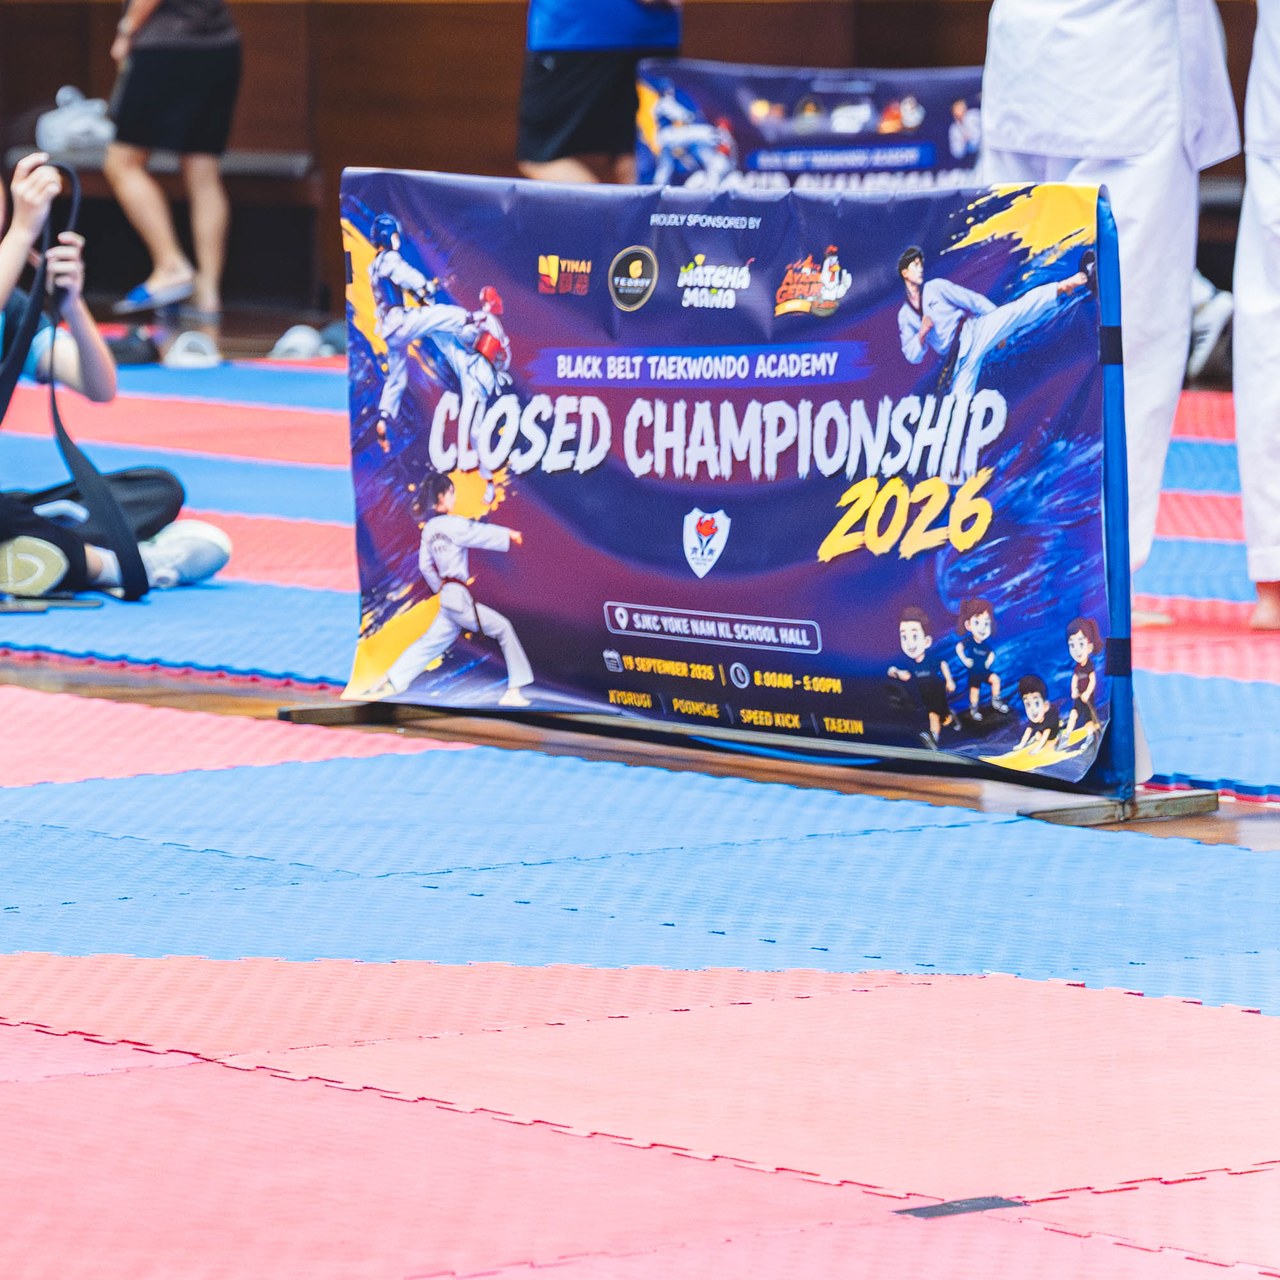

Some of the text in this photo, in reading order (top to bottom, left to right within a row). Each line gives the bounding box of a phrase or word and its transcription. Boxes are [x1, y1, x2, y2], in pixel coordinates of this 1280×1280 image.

[687, 213, 748, 229] SPONSORED
[748, 217, 762, 230] BY
[557, 352, 840, 380] BLACK BELT TAEKWONDO ACADEMY
[429, 388, 1008, 483] CLOSED CHAMPIONSHIP
[816, 467, 994, 563] 2026
[661, 615, 690, 634] YOKE
[691, 620, 717, 637] NAM
[717, 622, 733, 639] KL
[734, 623, 779, 644] SCHOOL
[779, 627, 811, 646] HALL
[635, 656, 689, 677] SEPTEMBER
[740, 709, 801, 729] SPEED KICK
[823, 716, 864, 735] TAEKIN
